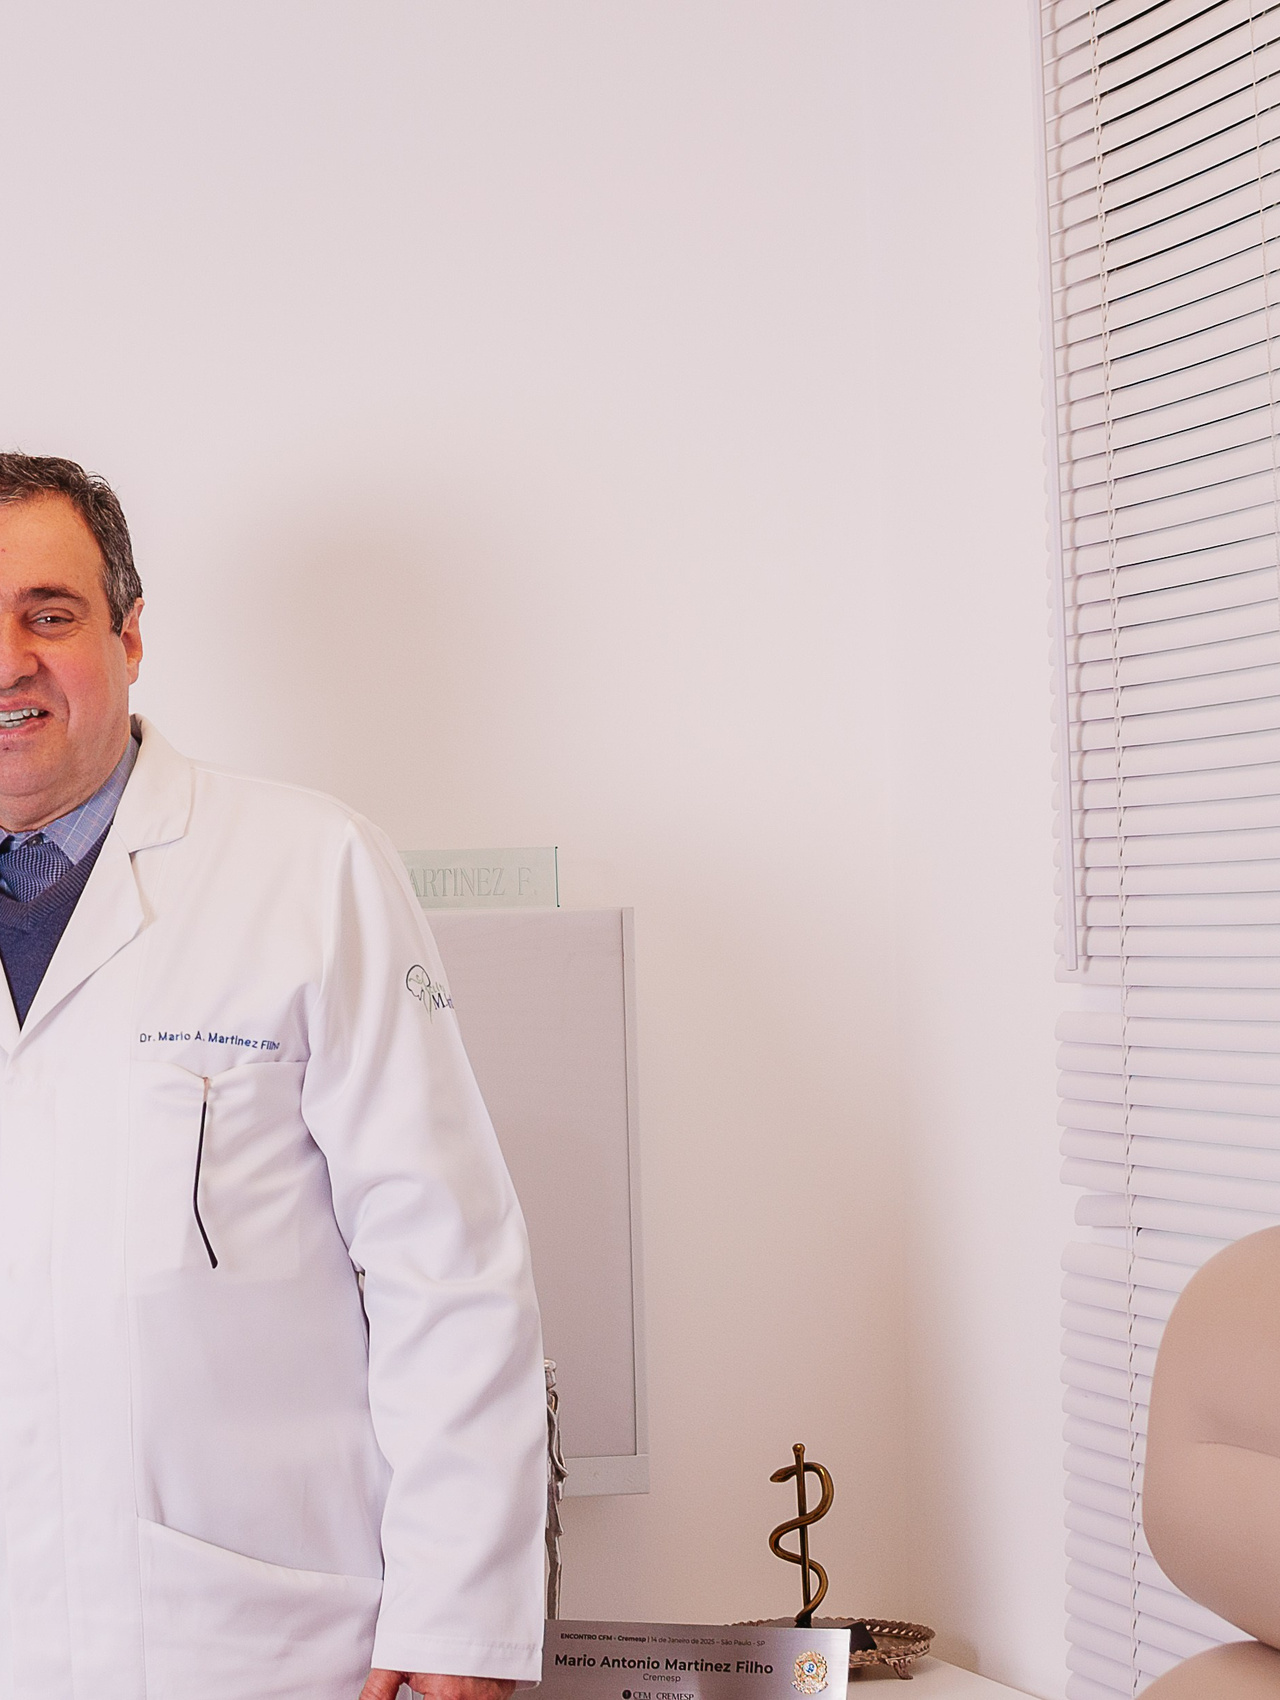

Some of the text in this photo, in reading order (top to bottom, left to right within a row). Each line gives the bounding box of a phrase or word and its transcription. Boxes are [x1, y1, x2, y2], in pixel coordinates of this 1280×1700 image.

[409, 867, 506, 897] ARTINEZ
[140, 1033, 156, 1043] Dr.
[158, 1031, 191, 1041] Mario
[194, 1031, 205, 1041] A.
[208, 1032, 258, 1048] Martinez
[560, 1633, 597, 1641] ENCONTRO
[617, 1635, 646, 1643] Cremesp
[555, 1654, 774, 1674] Mario Antonio Martinez Filho
[642, 1673, 681, 1683] Cremesp
[633, 1691, 694, 1700] CFM CREMESP
